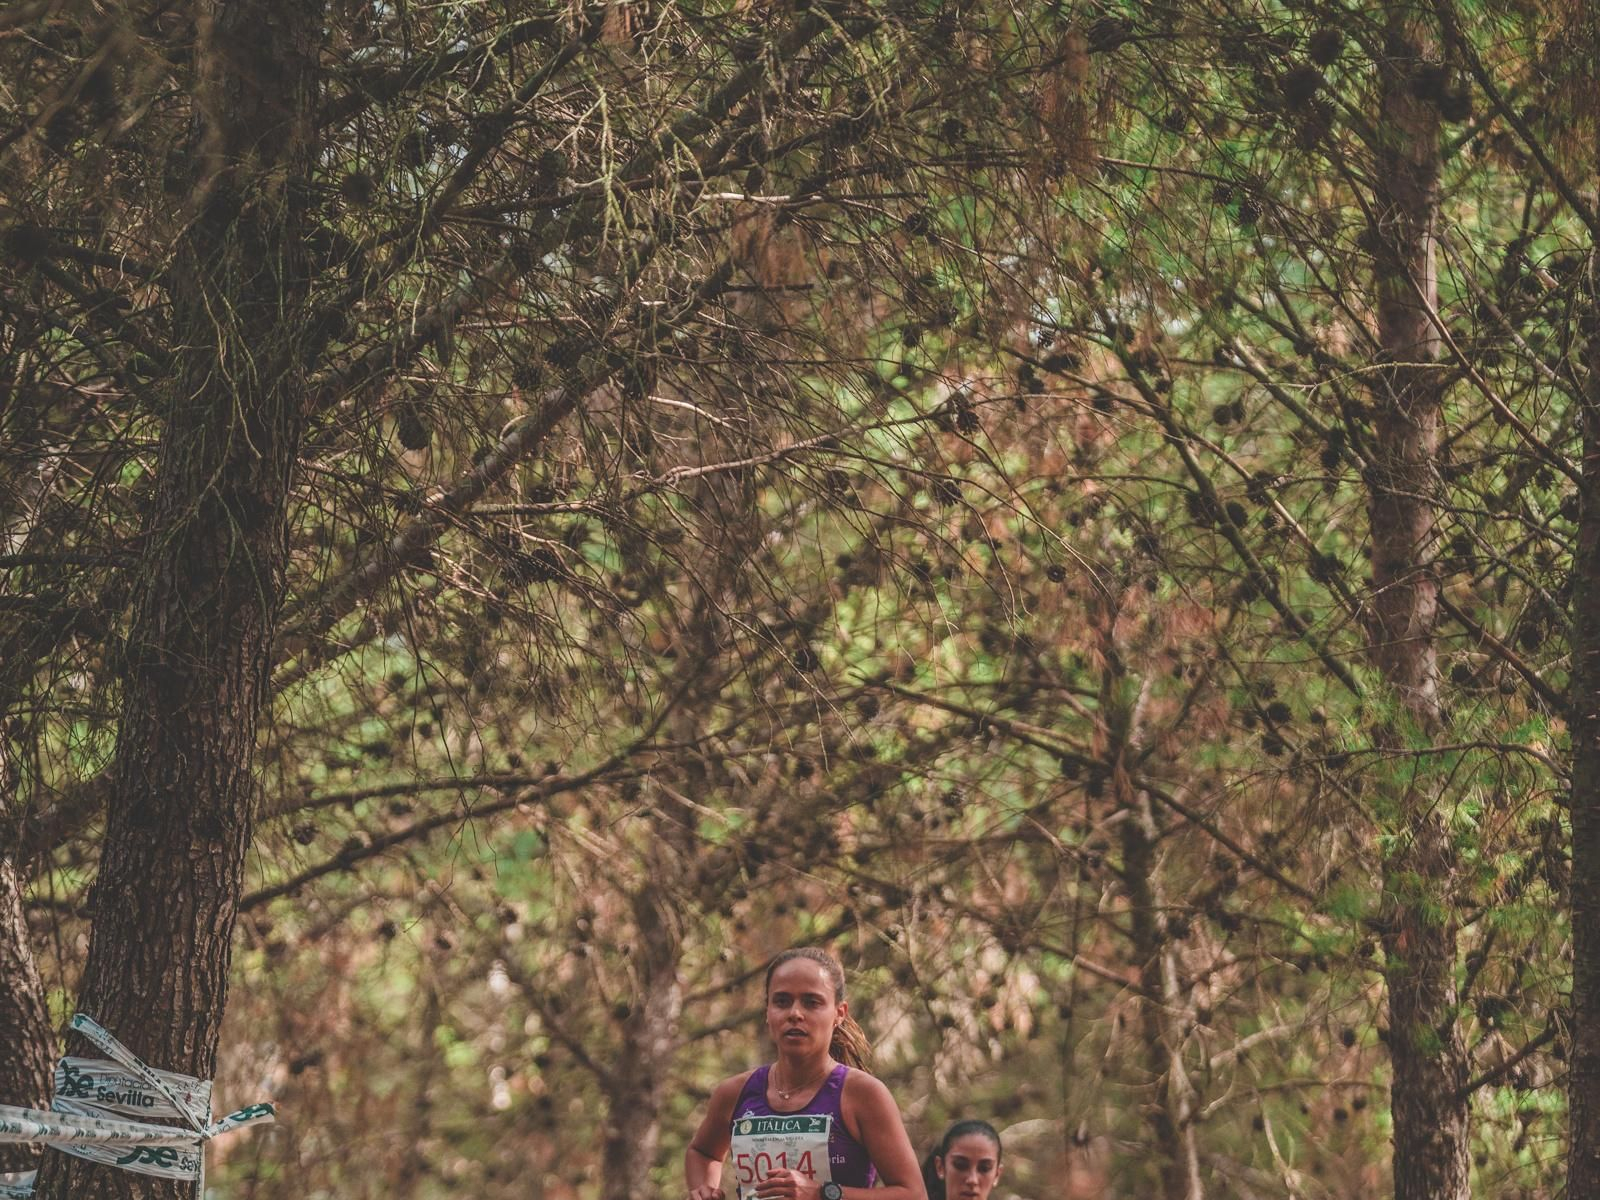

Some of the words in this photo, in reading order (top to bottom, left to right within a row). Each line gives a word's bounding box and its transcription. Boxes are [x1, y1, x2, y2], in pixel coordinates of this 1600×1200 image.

[96, 1085, 154, 1107] Sevilla
[757, 1119, 801, 1132] ITÁLICA
[737, 1150, 816, 1184] 5014
